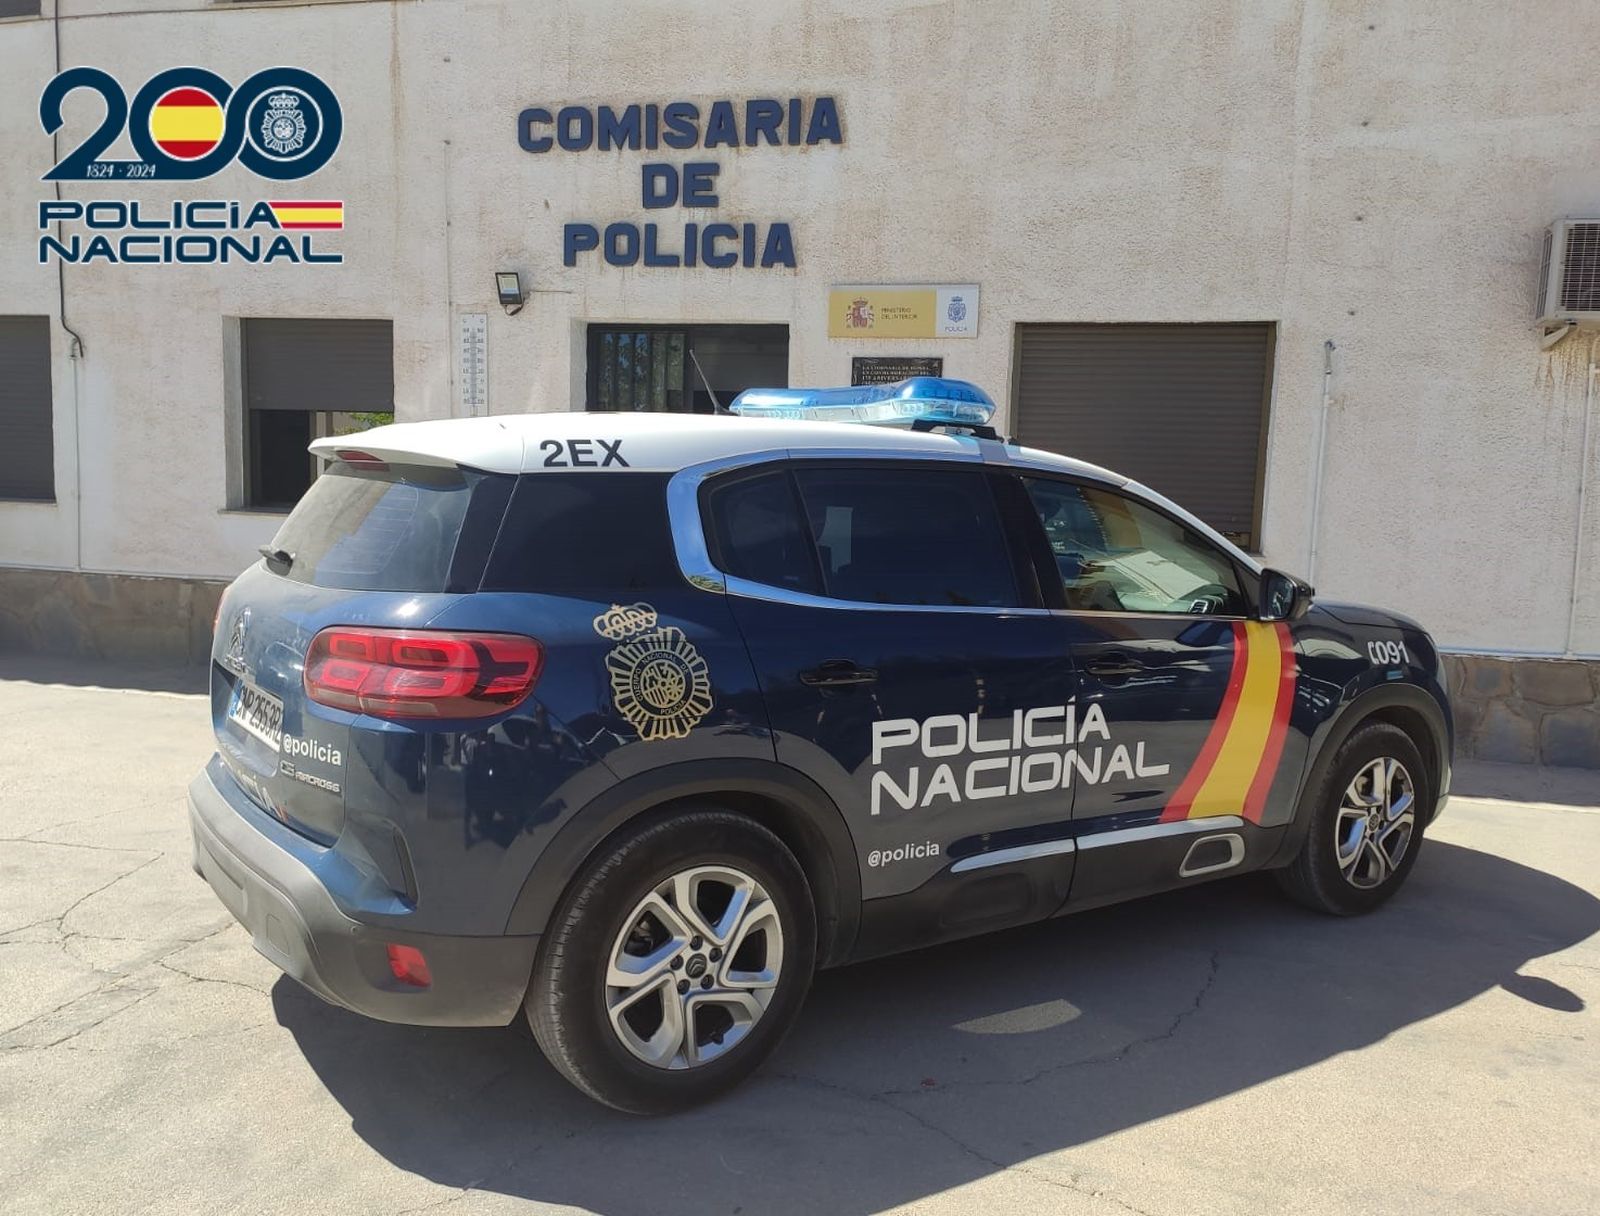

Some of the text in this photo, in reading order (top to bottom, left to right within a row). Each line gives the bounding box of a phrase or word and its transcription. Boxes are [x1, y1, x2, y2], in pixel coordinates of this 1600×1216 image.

[517, 97, 842, 153] COMISARIA
[642, 162, 720, 209] DE
[563, 222, 797, 268] POLICIA
[540, 439, 631, 467] 2EX
[1375, 641, 1410, 665] 091
[283, 733, 342, 766] @policia
[872, 695, 1111, 765] POLICÍA
[870, 741, 1170, 815] NACIONAL
[867, 840, 940, 868] @policia
